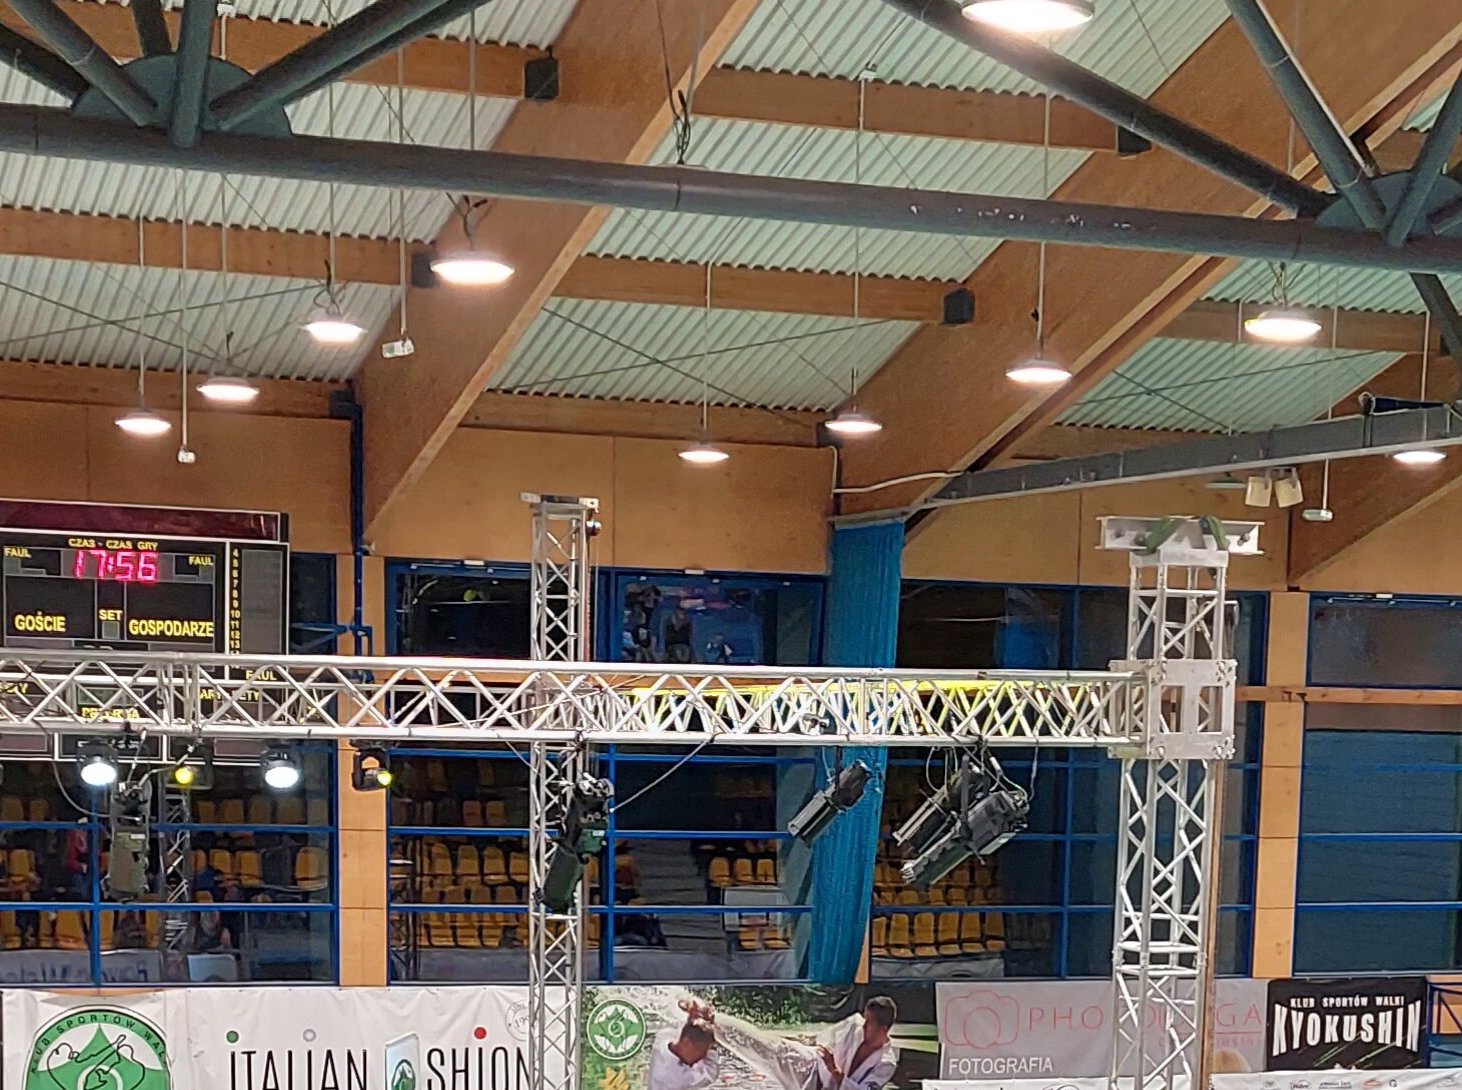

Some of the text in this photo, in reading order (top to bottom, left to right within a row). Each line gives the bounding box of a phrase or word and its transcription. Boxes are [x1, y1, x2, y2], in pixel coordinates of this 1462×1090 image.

[3, 547, 32, 558] FAUL
[68, 538, 159, 551] CZAS CZAS GRY
[73, 548, 159, 584] 17:56
[188, 555, 214, 566] FAUL
[14, 611, 67, 632] GOŚCIE
[98, 609, 123, 621] SET
[129, 619, 215, 637] GOSPODARZE
[1290, 994, 1405, 1009] KLUB SPORTÓW WALKI
[1272, 999, 1422, 1058] KYOKUSHIN
[948, 1056, 1055, 1075] FOTOGRAFIA
